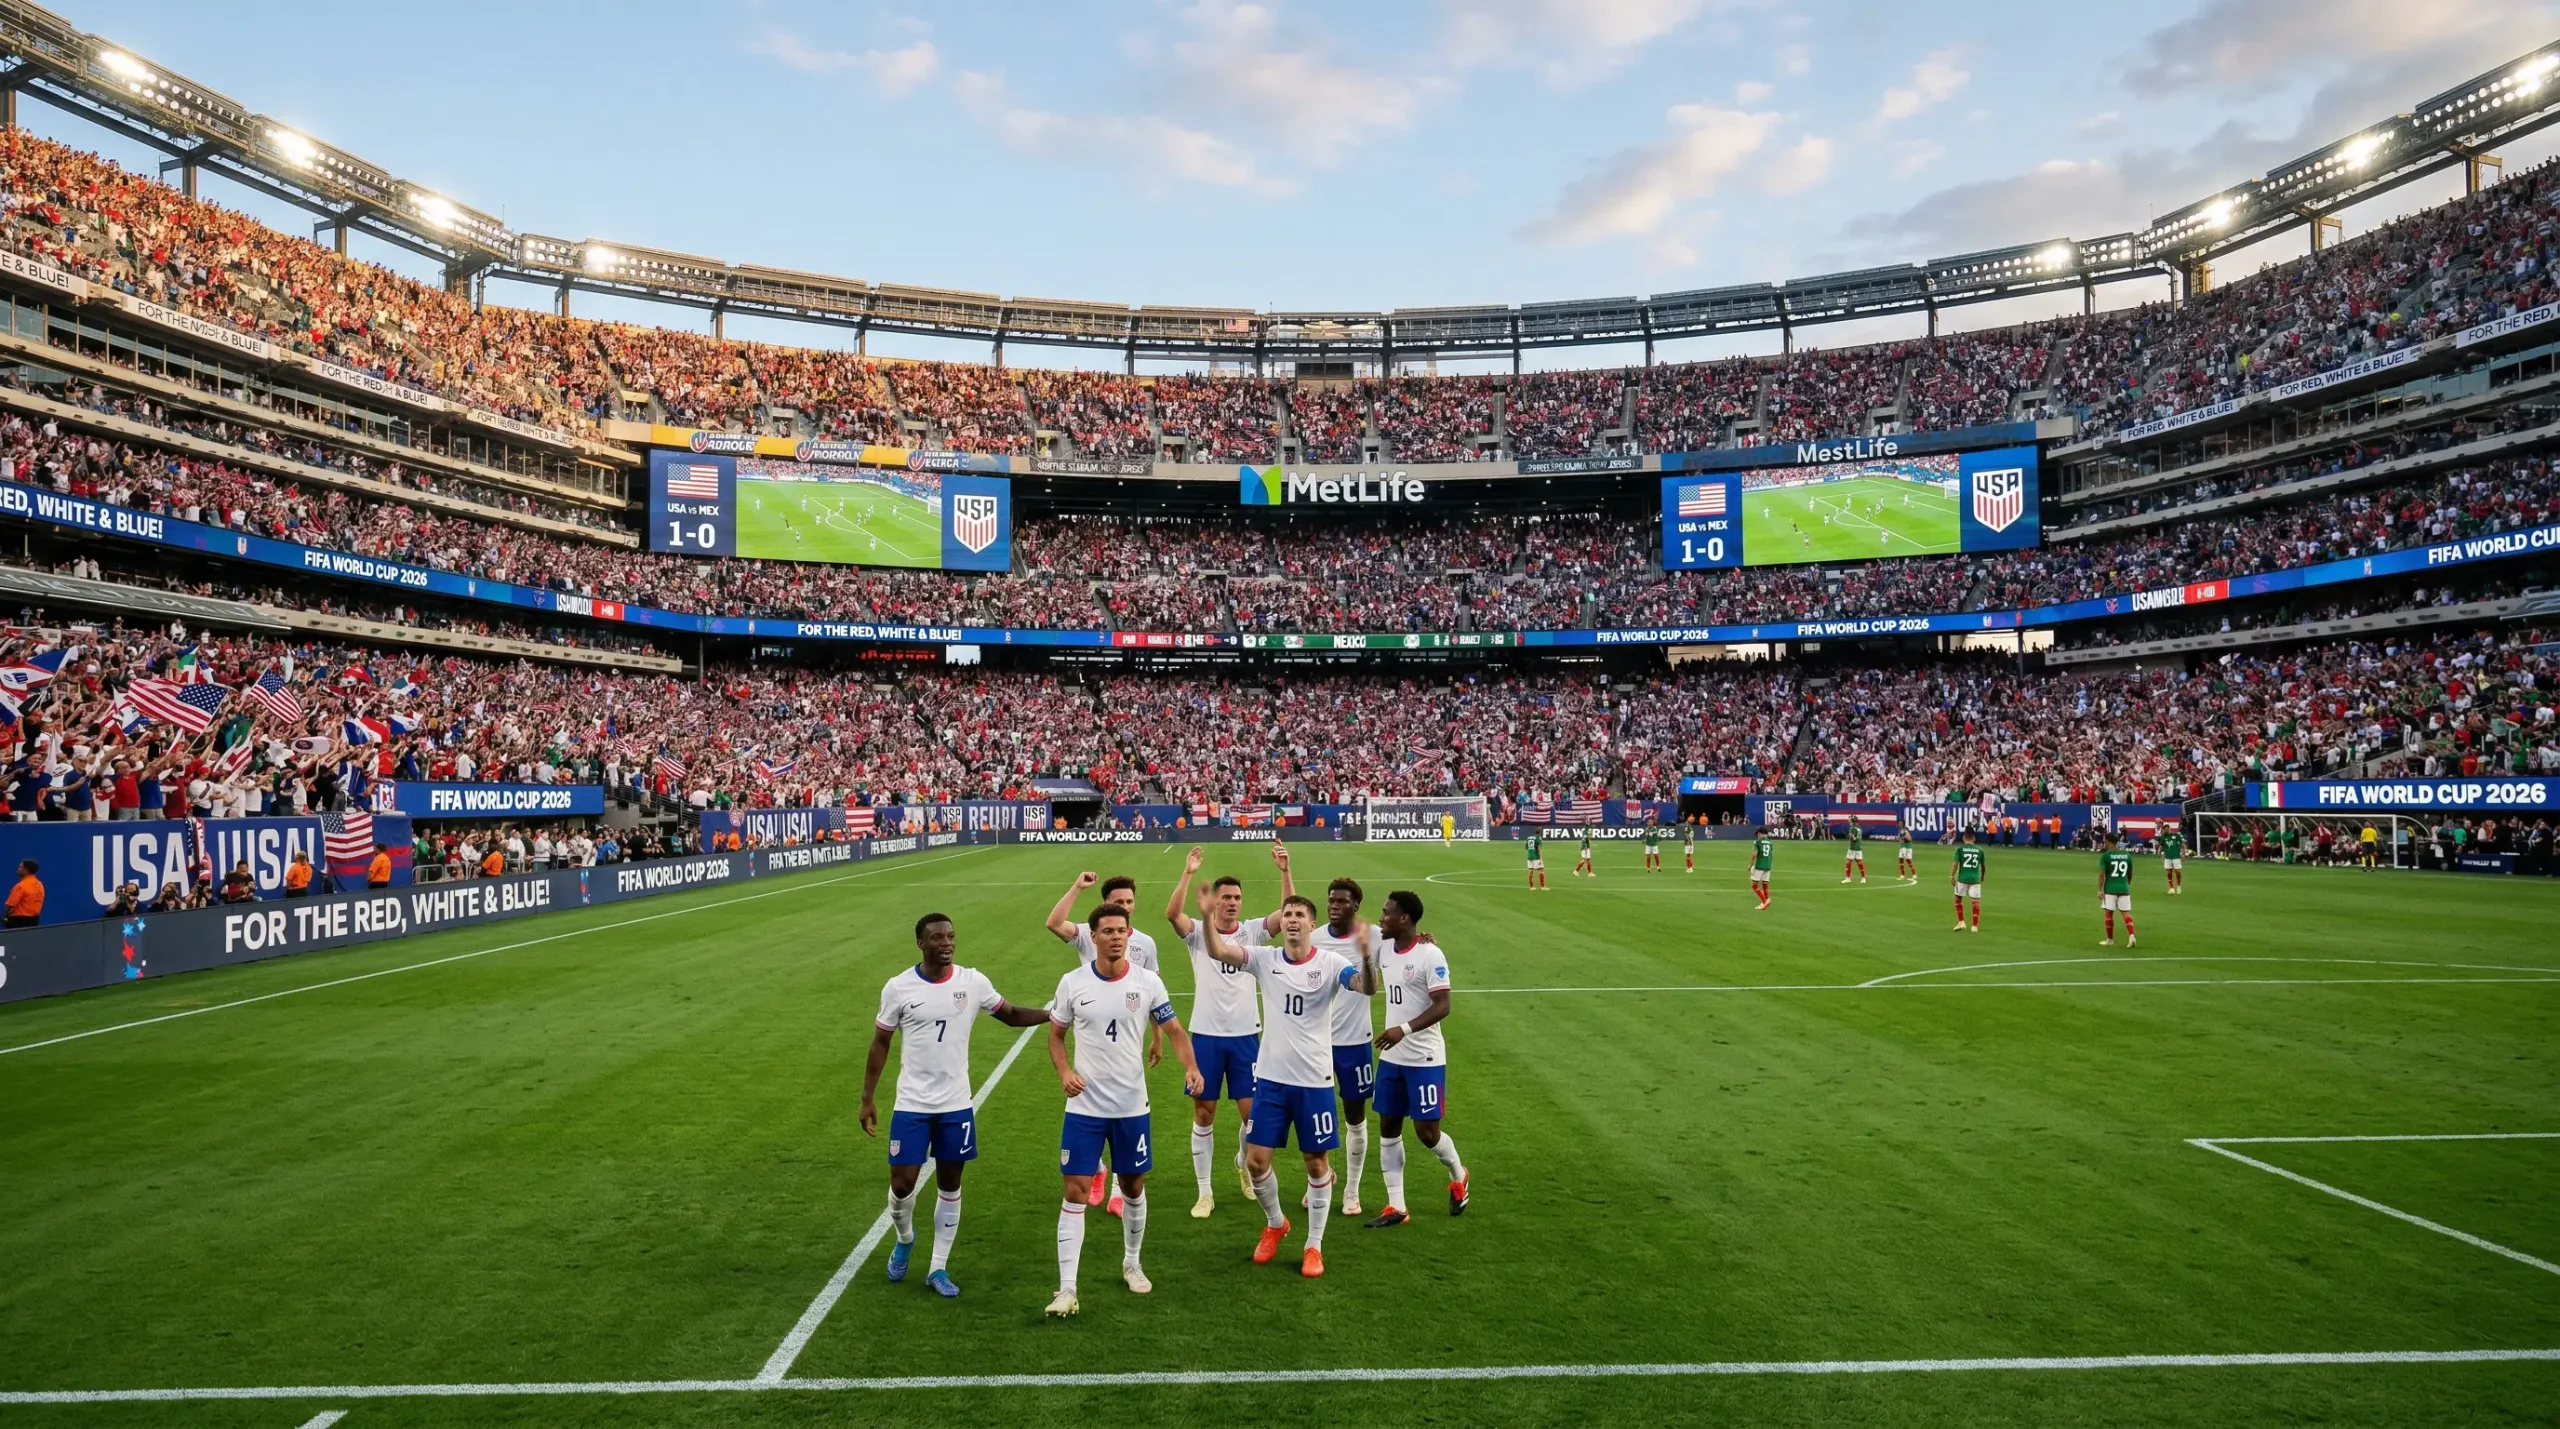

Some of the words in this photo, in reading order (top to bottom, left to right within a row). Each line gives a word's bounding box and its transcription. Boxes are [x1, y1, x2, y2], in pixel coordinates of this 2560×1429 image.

[15, 259, 25, 273] &
[29, 264, 69, 288] BLUE!
[138, 302, 163, 321] FOR
[166, 311, 189, 329] THE
[2469, 325, 2493, 340] FOR
[2496, 316, 2521, 332] THE
[2523, 307, 2554, 325] RED,
[321, 364, 342, 380] FOR
[344, 370, 362, 386] THE
[2279, 384, 2300, 396] FOR
[2301, 377, 2324, 390] RED,
[2325, 364, 2361, 383] WHITE
[2373, 352, 2404, 370] BLUE!
[2128, 427, 2145, 438] FOR
[2167, 411, 2197, 428] WHITE
[1797, 437, 1898, 463] MestLife
[1288, 470, 1425, 503] MetLife
[1977, 472, 2018, 497] USA
[0, 486, 33, 518] ED,
[37, 493, 95, 526] WHITE
[99, 508, 112, 528] &
[116, 512, 163, 539] BLUE!
[667, 502, 687, 514] USA
[699, 504, 719, 516] MEX
[957, 498, 994, 519] USA
[669, 521, 715, 548] 1-0
[1678, 522, 1697, 532] USA
[1682, 537, 1724, 562] 1-0
[2428, 545, 2463, 564] FIFA
[2465, 533, 2527, 557] WORLD
[304, 550, 331, 570] FIFA
[333, 554, 374, 577] WORLD
[376, 560, 399, 580] CUP
[400, 568, 428, 587] 2026
[798, 624, 822, 635] FOR
[823, 625, 848, 637] THE
[850, 626, 876, 640] RED,
[878, 627, 916, 640] WHITE
[1597, 632, 1620, 642] FIFA
[1620, 630, 1658, 641] WORLD
[1660, 630, 1681, 640] CUP
[1682, 629, 1709, 640] 2026
[1797, 624, 1824, 635] FIFA
[1825, 622, 1869, 634] WORLD
[1871, 620, 1897, 632] CUP
[1899, 619, 1929, 631] 2026
[431, 790, 463, 811] FIFA
[465, 790, 512, 810] WORLD
[514, 790, 540, 809] CUP
[542, 790, 571, 809] 2026
[2319, 785, 2358, 804] FIFA
[2361, 784, 2434, 804] WORLD
[2437, 784, 2482, 804] CUP
[2486, 783, 2546, 804] 2026
[1020, 832, 1044, 841] FIFA
[1046, 832, 1090, 841] WORLD
[1092, 831, 1113, 841] CUP
[1114, 831, 1143, 841] 2026
[1370, 829, 1395, 839] FIFA
[1397, 829, 1442, 838] WORLD
[1543, 829, 1570, 838] FIFA
[1572, 828, 1616, 838] WRLD
[1618, 828, 1644, 838] CUP
[92, 832, 190, 905] USA
[1963, 854, 1979, 868] 23
[2111, 861, 2128, 877] 29
[618, 870, 643, 892] FIFA
[645, 865, 683, 888] WORLD
[684, 862, 705, 882] CUP
[707, 858, 730, 879] 2026
[226, 911, 287, 953] FOR
[294, 902, 348, 942] THE
[356, 897, 406, 934] RED,
[412, 887, 479, 924] WHITE
[484, 886, 498, 914] &
[502, 879, 550, 911] BLUE!
[1284, 994, 1303, 1016] 10
[1390, 985, 1402, 1005] 10
[935, 1020, 947, 1042] 7
[1105, 1019, 1117, 1042] 4
[1355, 1063, 1373, 1087] 10
[1418, 1084, 1437, 1107] 10
[961, 1122, 971, 1145] 7
[1313, 1111, 1333, 1135] 10
[1136, 1134, 1147, 1156] 4
